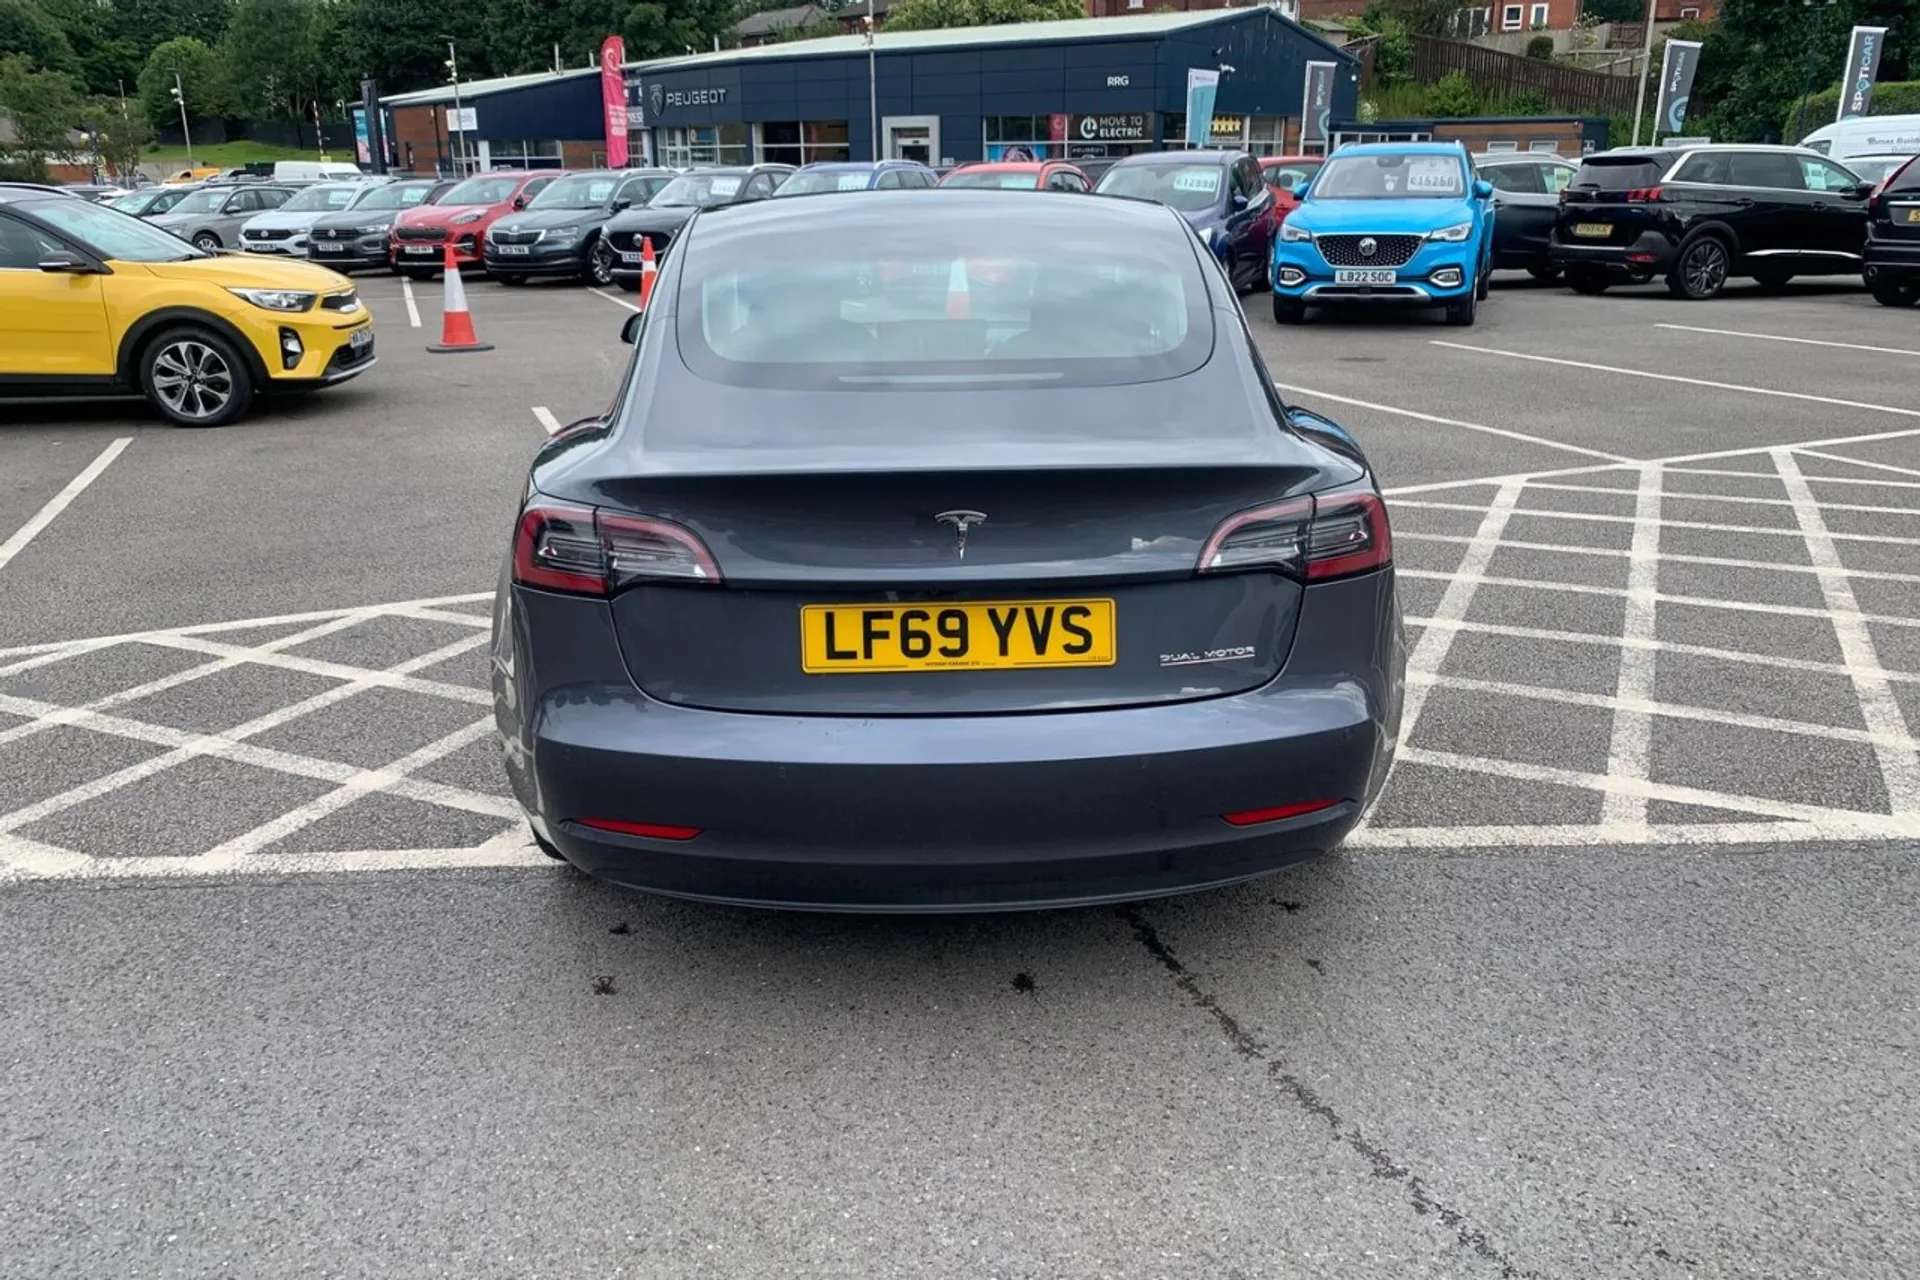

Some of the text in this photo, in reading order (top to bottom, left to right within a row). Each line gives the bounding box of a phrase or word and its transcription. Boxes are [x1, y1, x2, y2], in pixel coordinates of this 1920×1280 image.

[1852, 35, 1876, 111] SPOTICAR
[1106, 75, 1130, 87] RRG
[665, 88, 727, 106] PEUGEOT
[1099, 115, 1144, 126] MOVE TO
[1099, 127, 1144, 138] ELECTRIC
[1339, 270, 1393, 282] LB22 SOC
[824, 605, 1094, 660] LF69 YVS
[1160, 646, 1256, 662] DUAL MOTOR
